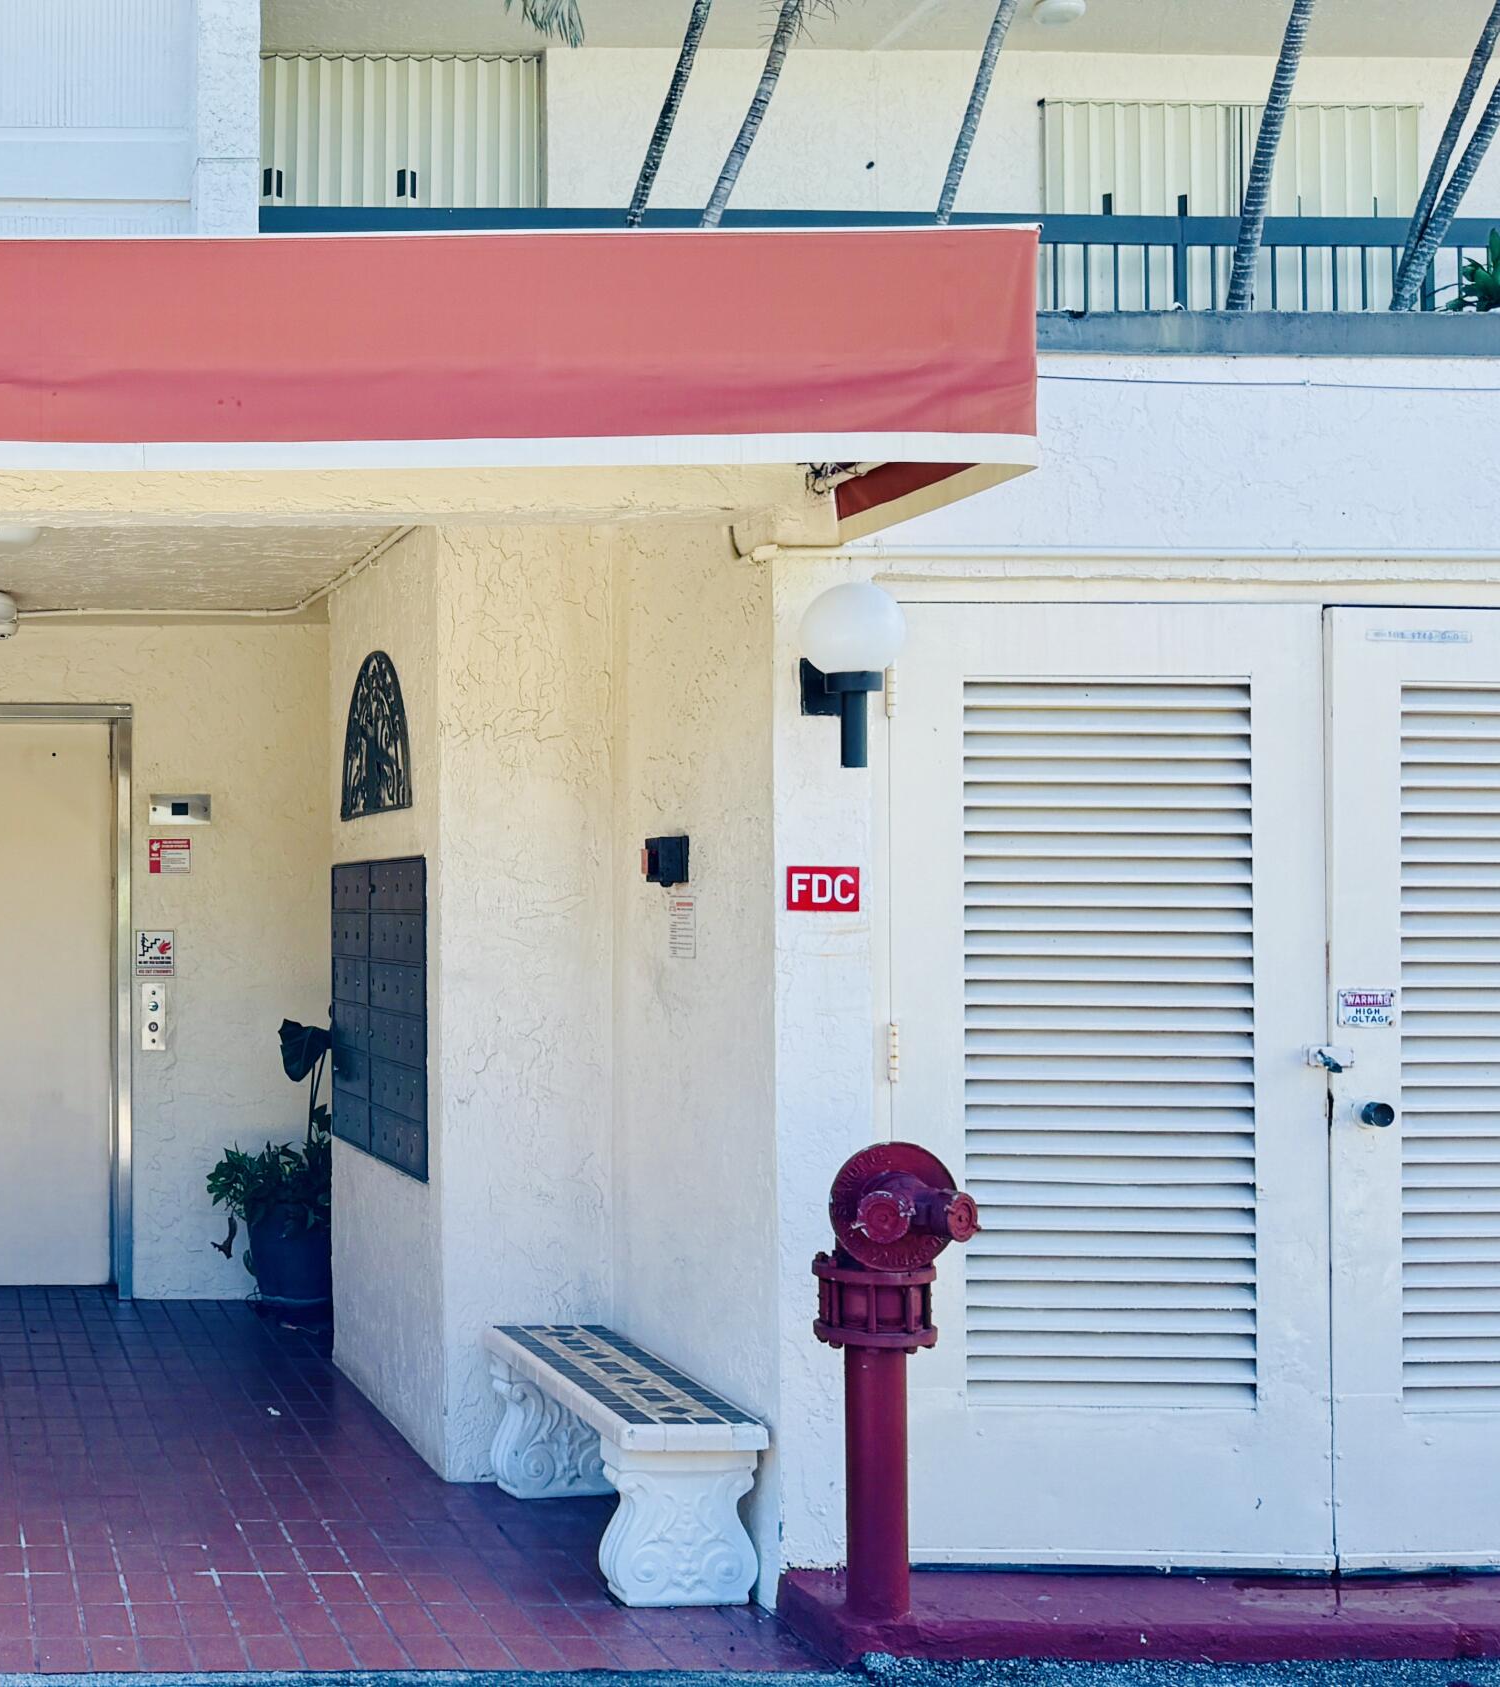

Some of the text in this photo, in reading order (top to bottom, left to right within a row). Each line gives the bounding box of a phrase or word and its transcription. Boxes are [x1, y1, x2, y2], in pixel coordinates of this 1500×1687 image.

[791, 873, 855, 904] FDC
[1347, 994, 1390, 1005] WARNING
[1355, 1007, 1380, 1015] HIGH
